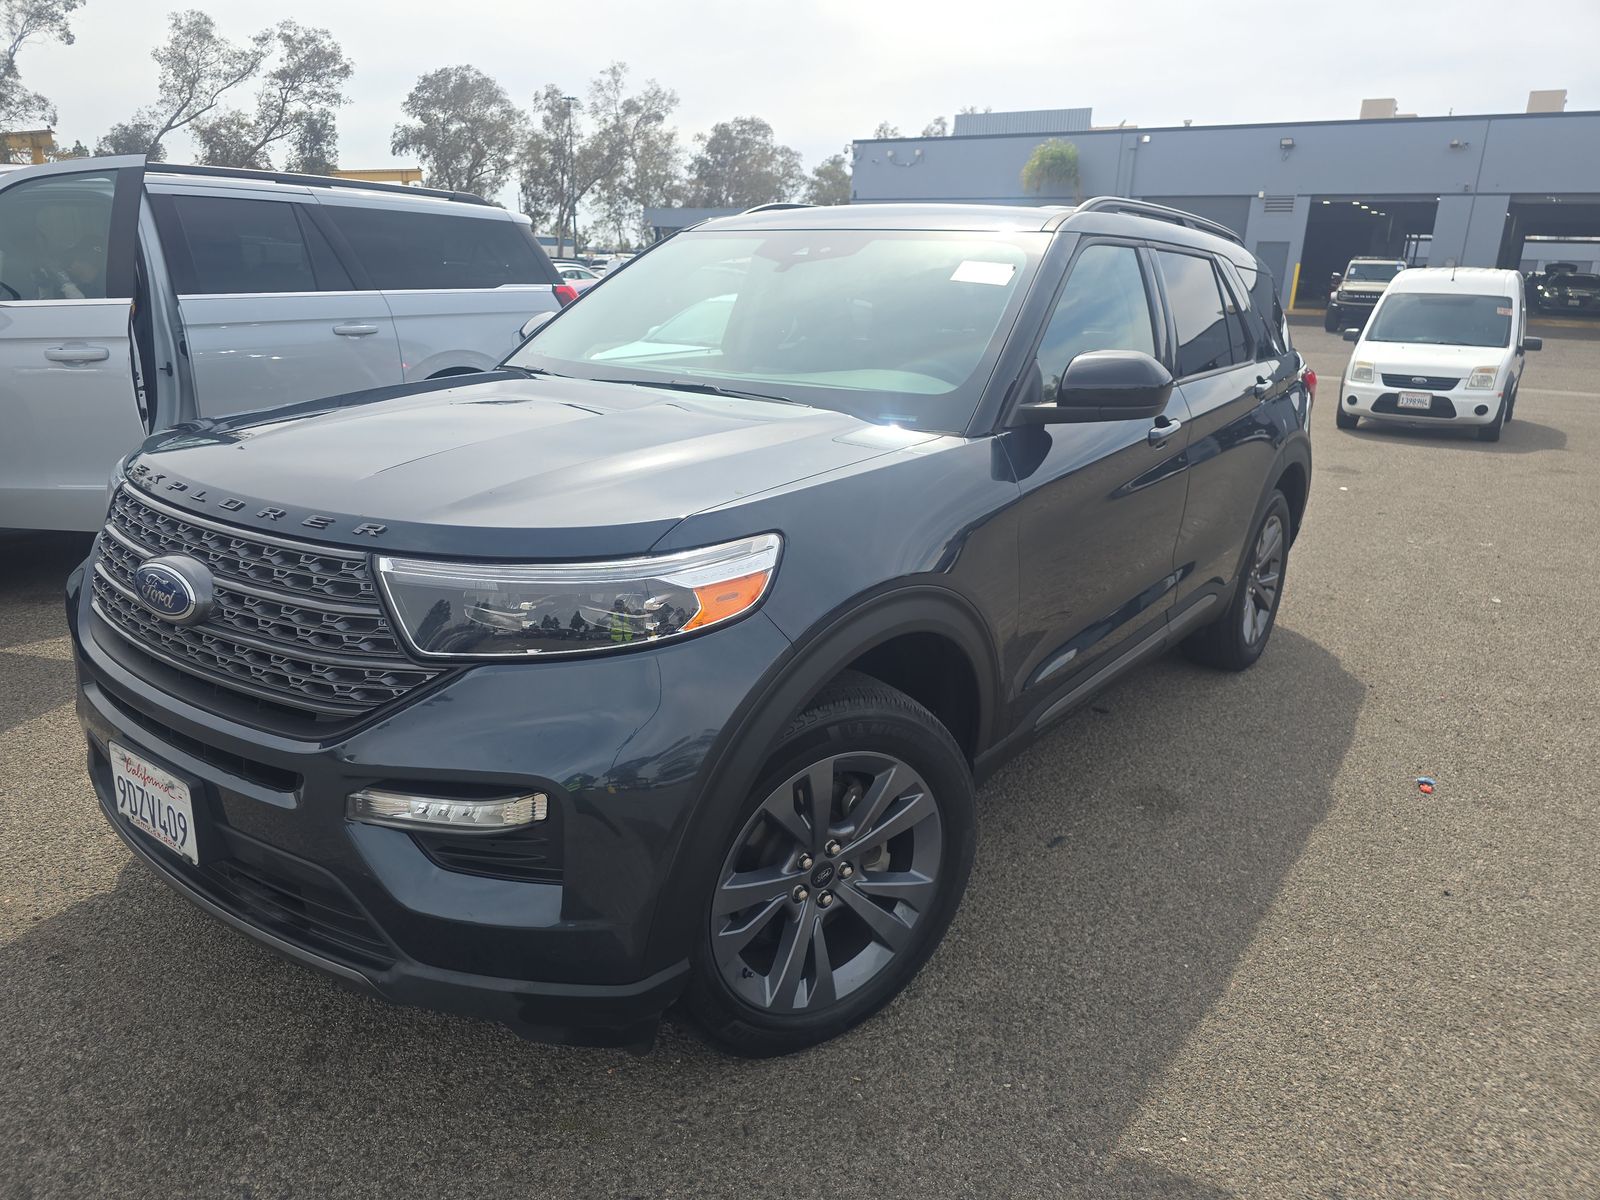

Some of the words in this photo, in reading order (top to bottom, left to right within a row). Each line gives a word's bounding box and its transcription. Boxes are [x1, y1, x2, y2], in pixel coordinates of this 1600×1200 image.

[134, 463, 389, 538] EXPLORER
[141, 573, 176, 609] Ford
[124, 757, 176, 800] California
[117, 775, 188, 847] 9DZV409
